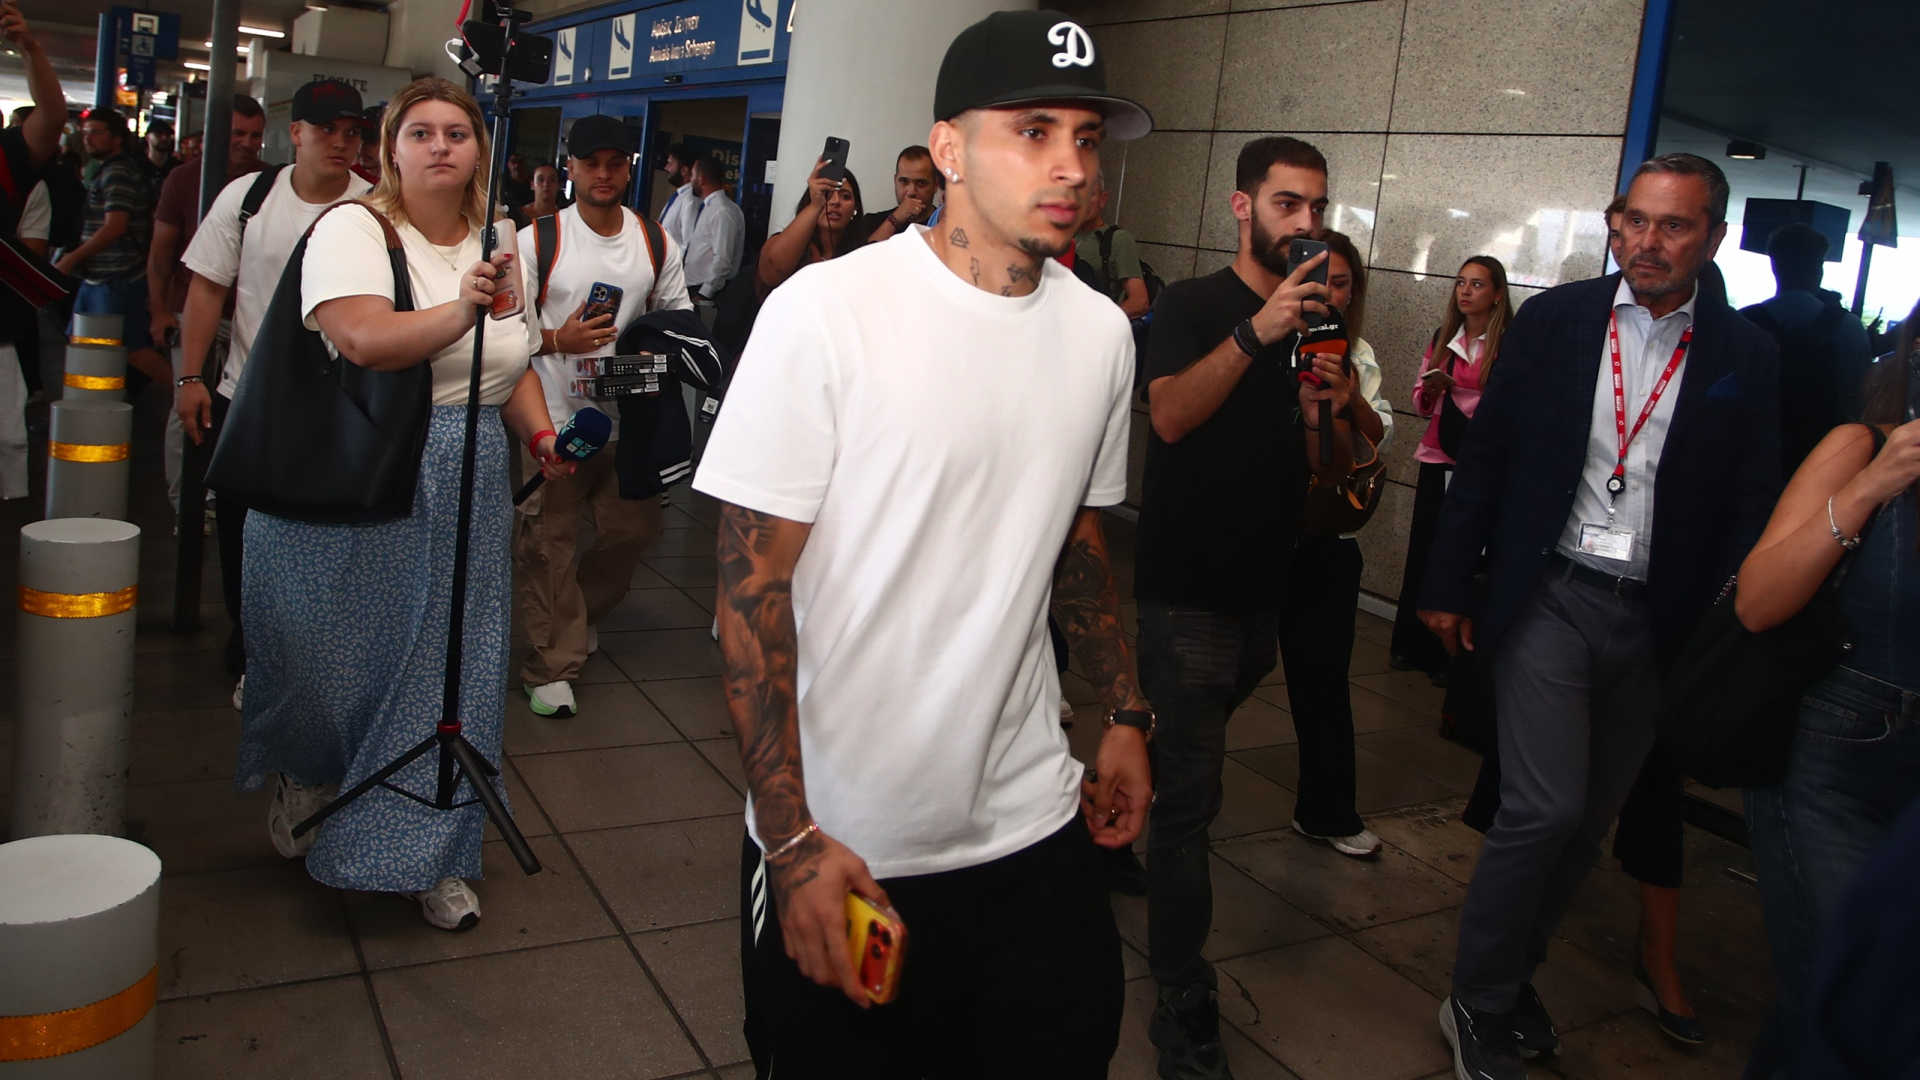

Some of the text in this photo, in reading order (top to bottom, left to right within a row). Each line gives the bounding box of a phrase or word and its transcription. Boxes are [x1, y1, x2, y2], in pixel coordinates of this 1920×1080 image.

[649, 44, 670, 62] Arrivals
[685, 39, 716, 60] Schengen
[1047, 21, 1095, 68] D
